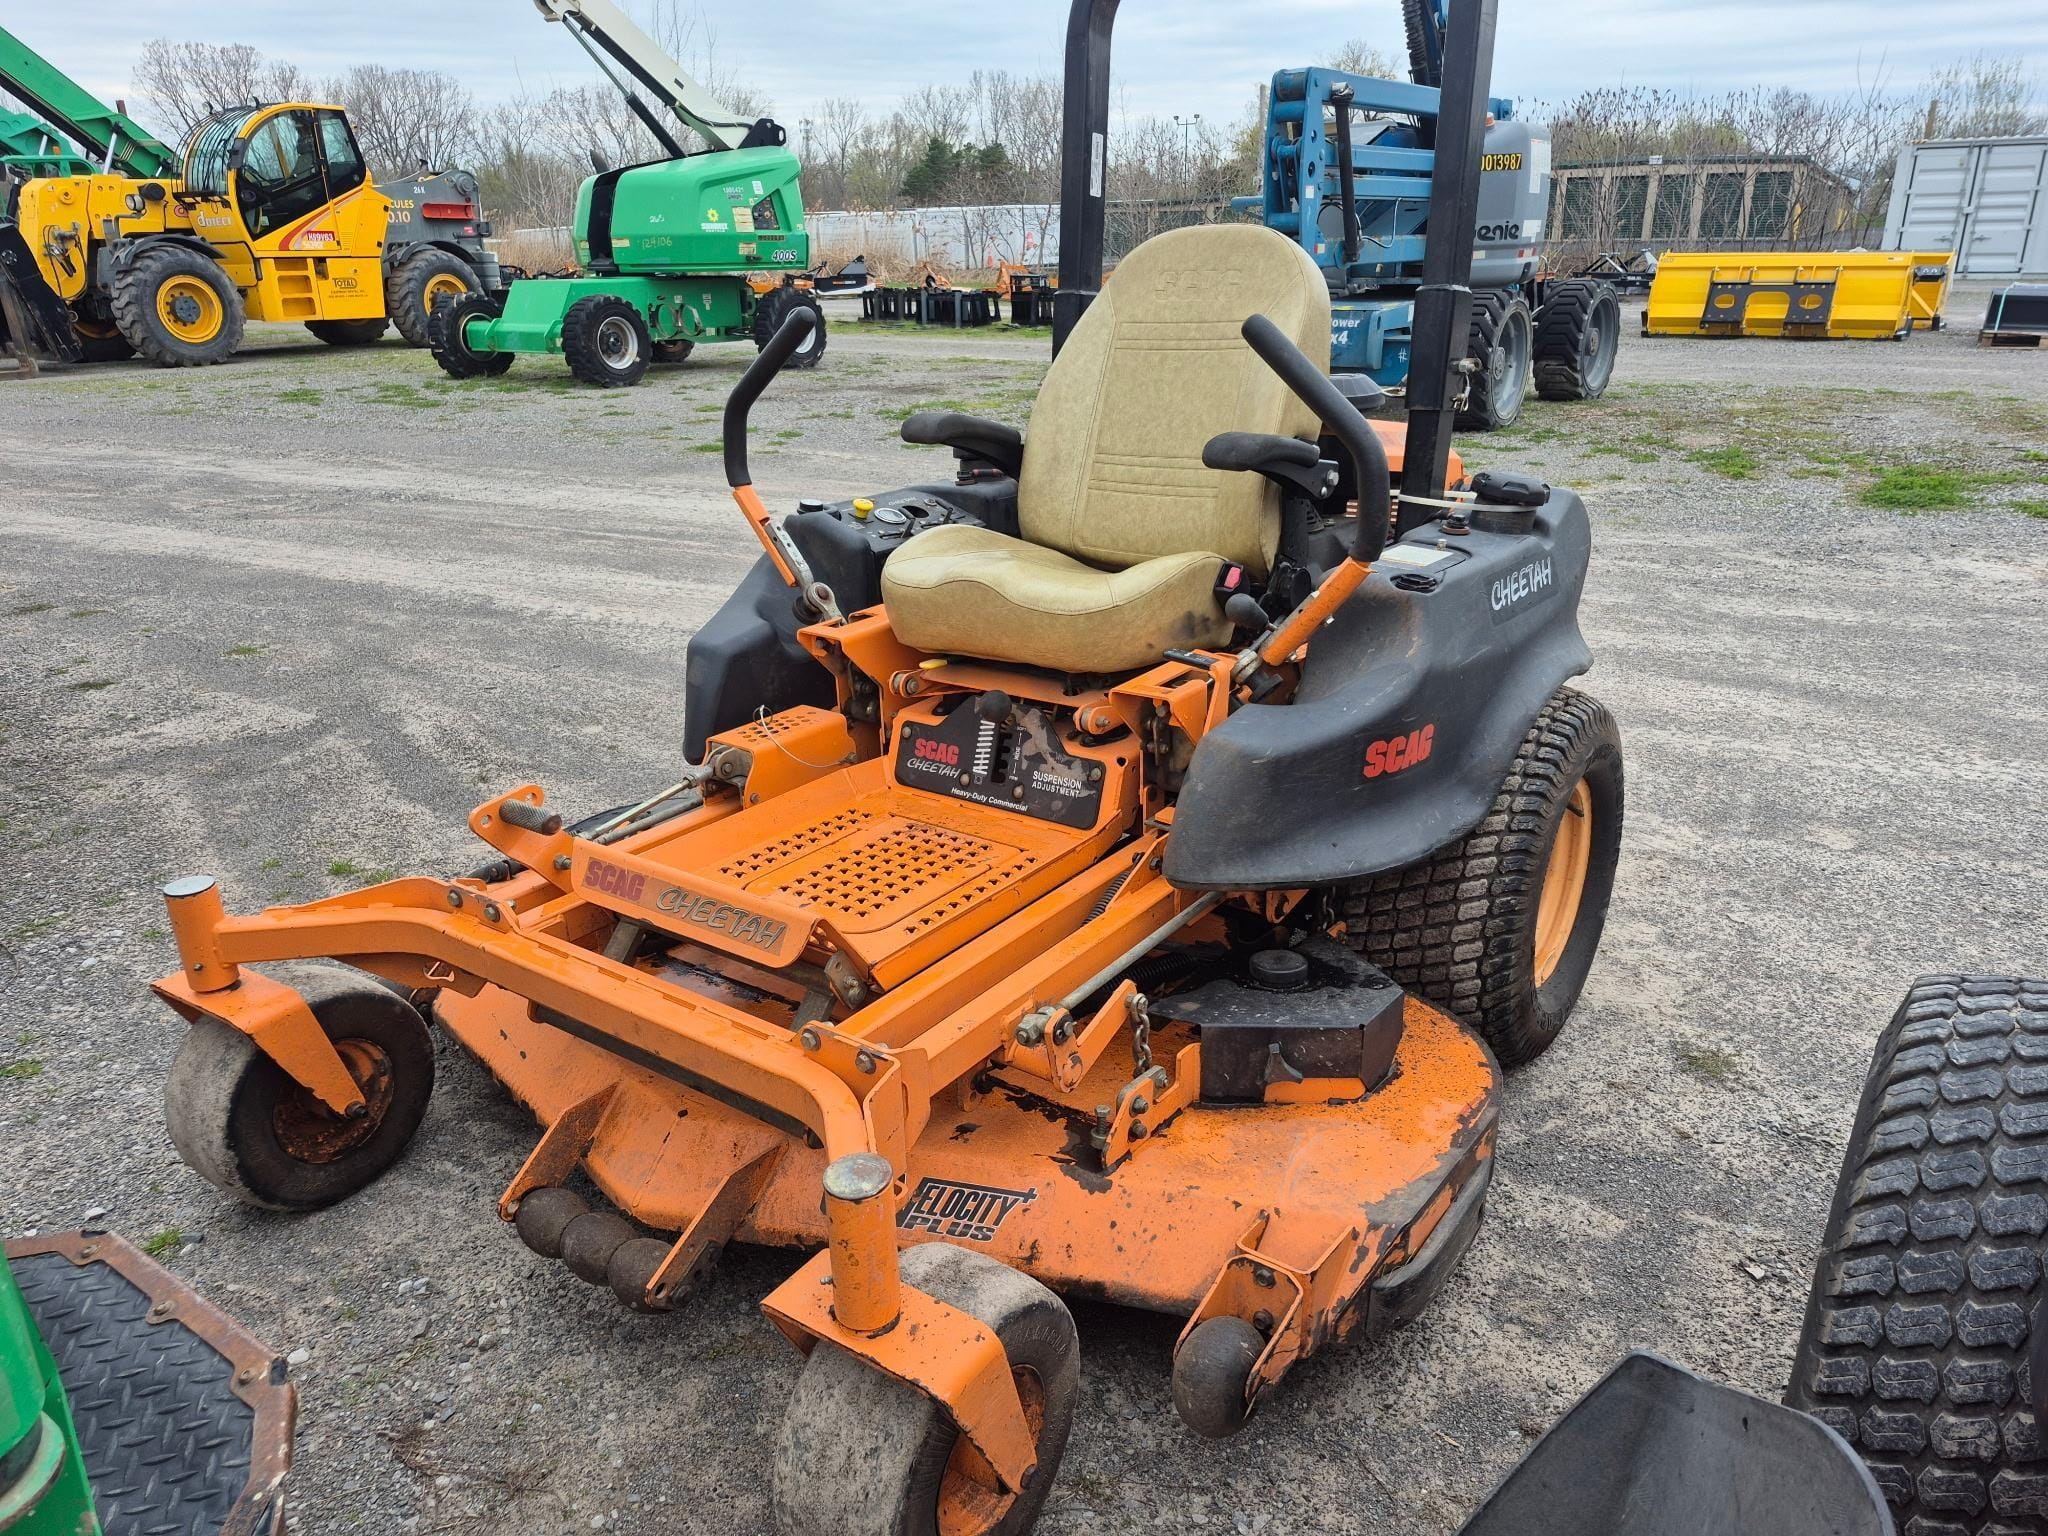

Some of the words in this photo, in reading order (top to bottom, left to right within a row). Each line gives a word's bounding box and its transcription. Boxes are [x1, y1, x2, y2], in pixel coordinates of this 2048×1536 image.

[390, 200, 414, 209] CULES
[772, 250, 797, 262] 400S
[1331, 318, 1360, 328] ower
[1331, 330, 1348, 345] x4
[1491, 556, 1552, 611] CHEETAH
[914, 738, 960, 765] SCAG
[1363, 723, 1435, 778] SCAG
[907, 758, 961, 778] CHEETAH
[1031, 781, 1080, 798] ADJUSTMENT
[1032, 771, 1082, 790] SUSPENSION
[951, 787, 988, 803] Heavy-Duty
[988, 796, 1029, 812] Commercial
[586, 861, 646, 900] SCAG
[656, 887, 785, 949] CHEETAH
[903, 1214, 997, 1242] PLUS
